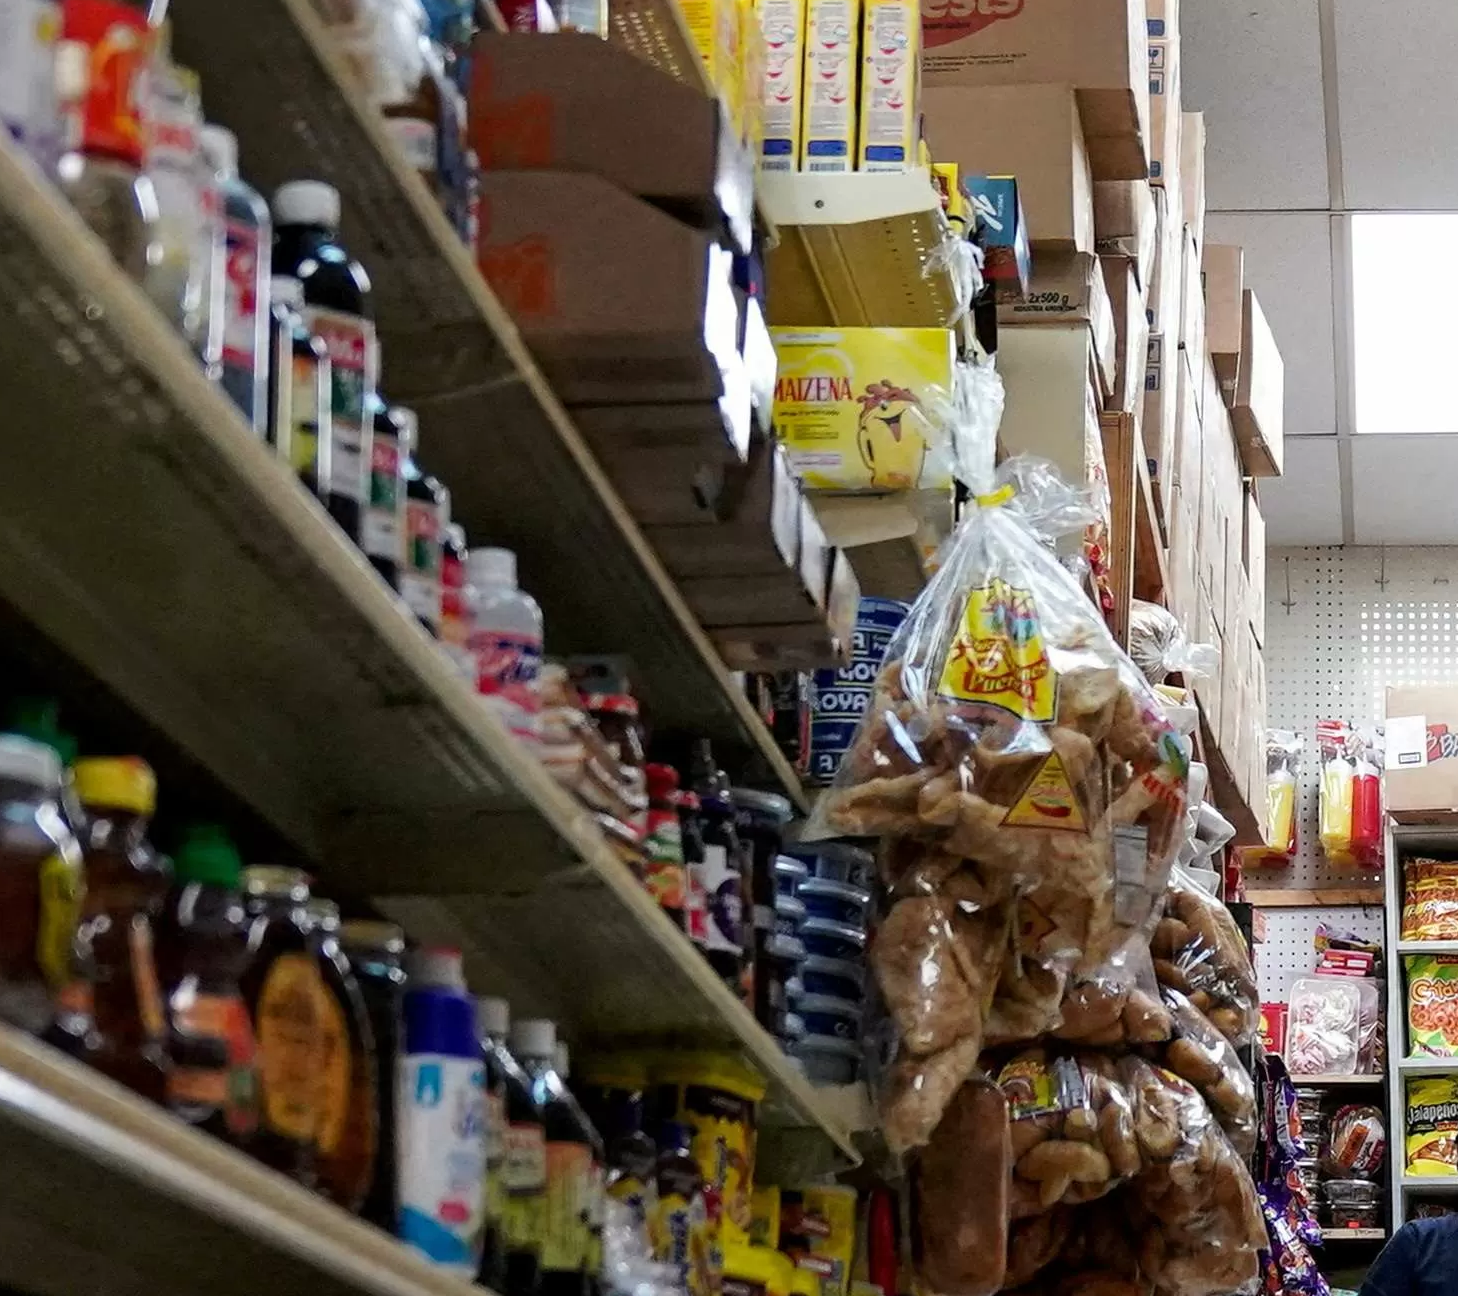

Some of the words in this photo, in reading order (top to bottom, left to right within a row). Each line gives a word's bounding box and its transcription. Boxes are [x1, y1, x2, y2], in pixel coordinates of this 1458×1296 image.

[1028, 292, 1059, 304] 2x500
[1062, 294, 1069, 305] g
[774, 376, 853, 402] MAIZENA
